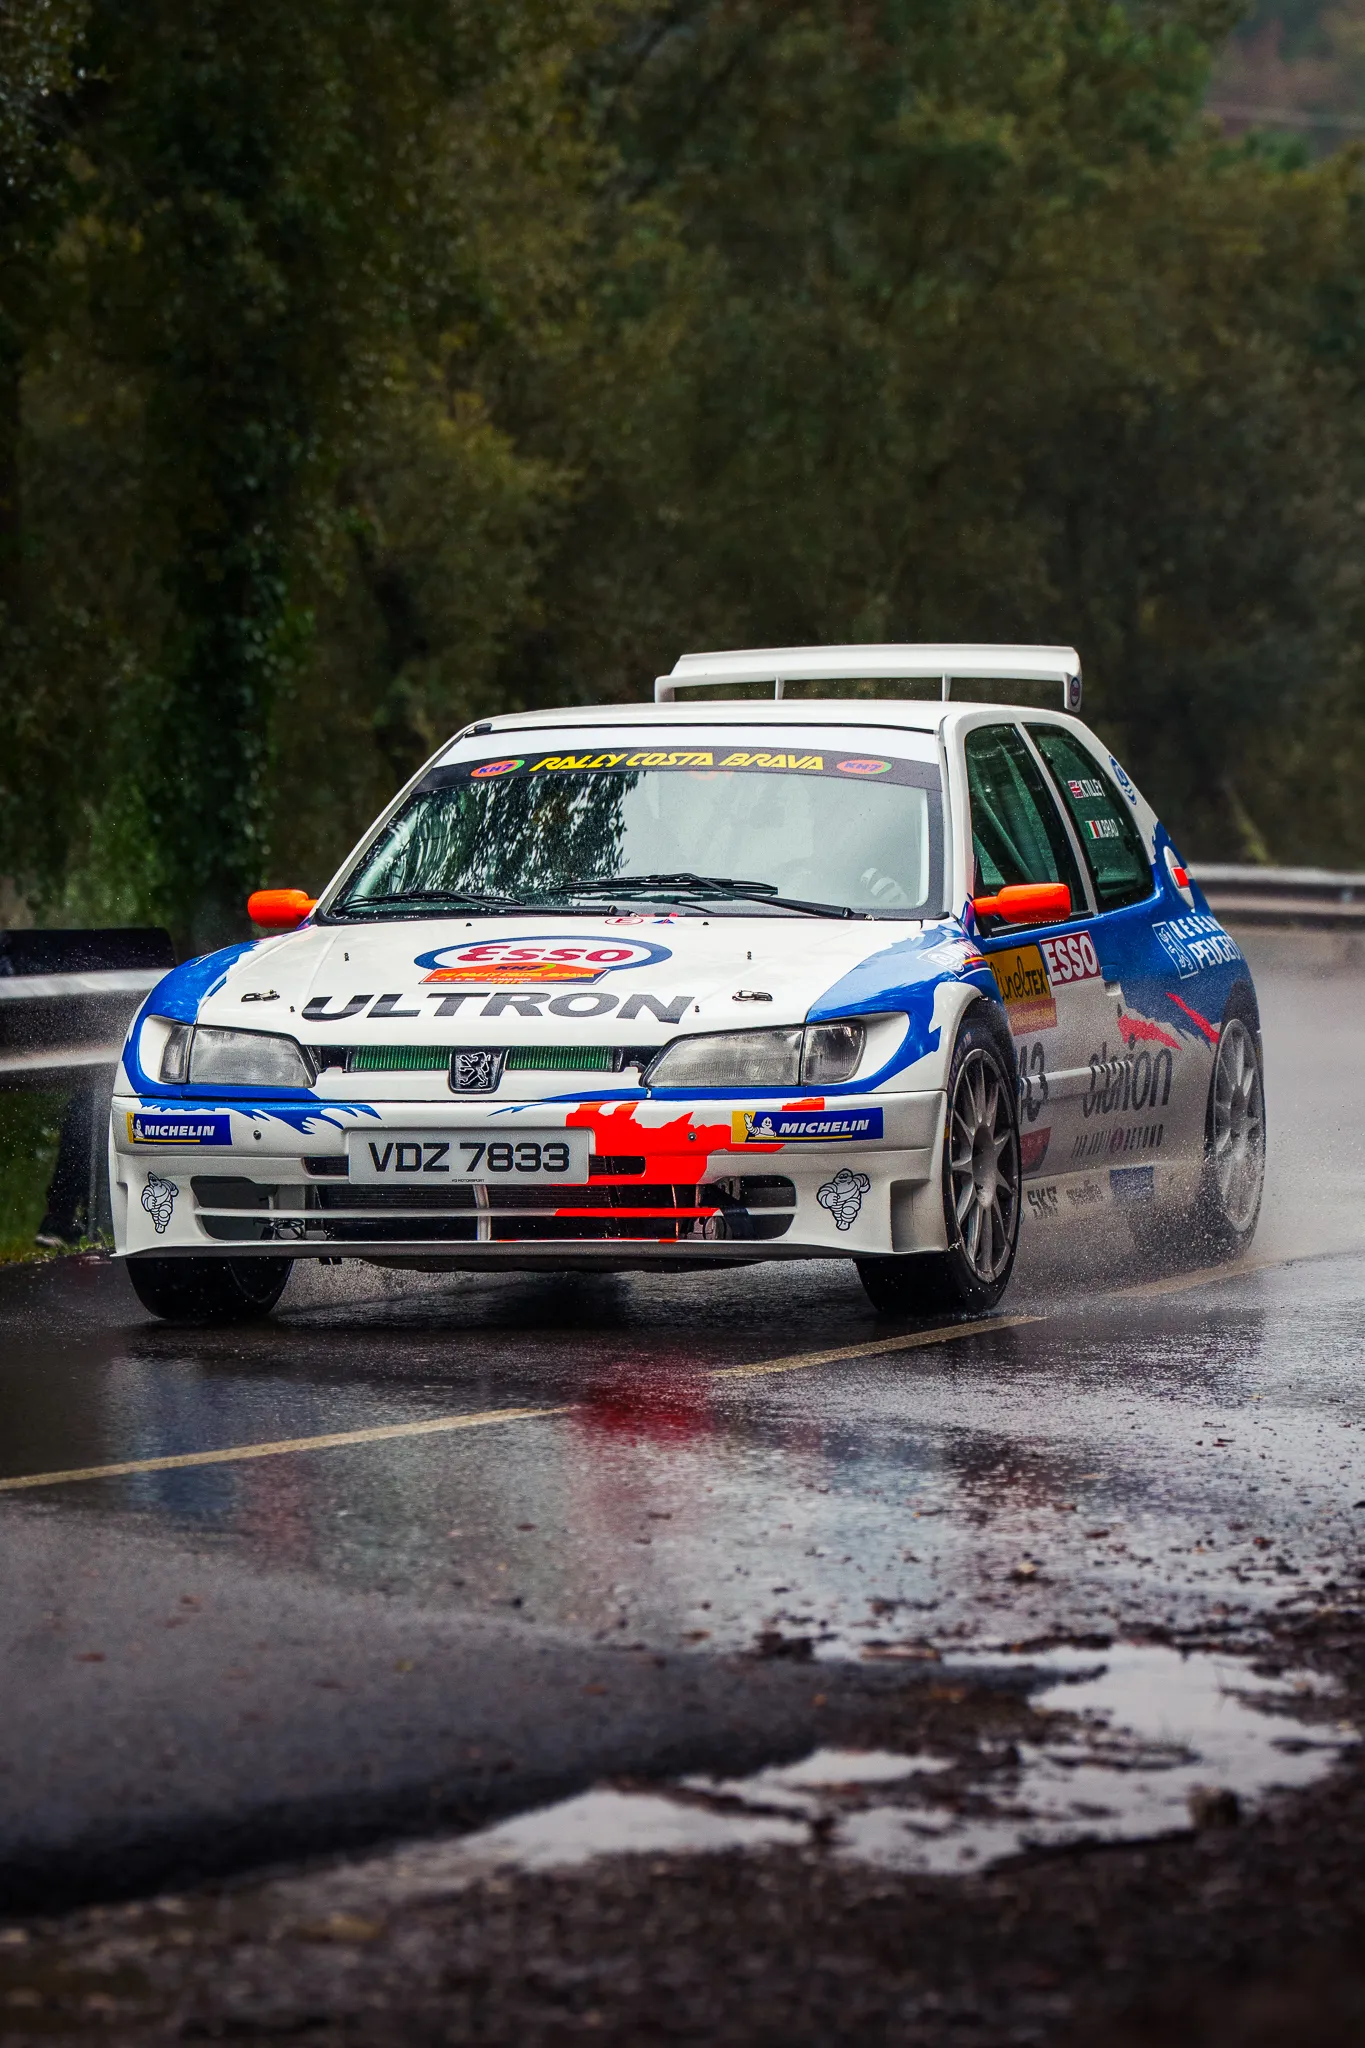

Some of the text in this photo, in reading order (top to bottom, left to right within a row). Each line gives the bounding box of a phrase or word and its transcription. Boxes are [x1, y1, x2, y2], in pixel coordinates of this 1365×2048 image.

[478, 762, 514, 774] KH7
[529, 752, 824, 771] RALLY COSTA BRAVA
[844, 762, 882, 772] KH7
[1042, 935, 1099, 982] ESSO
[301, 991, 694, 1025] ULTRON
[143, 1124, 216, 1138] MICHELIN
[778, 1118, 870, 1134] MICHELIN
[367, 1142, 570, 1173] VDZ 7833
